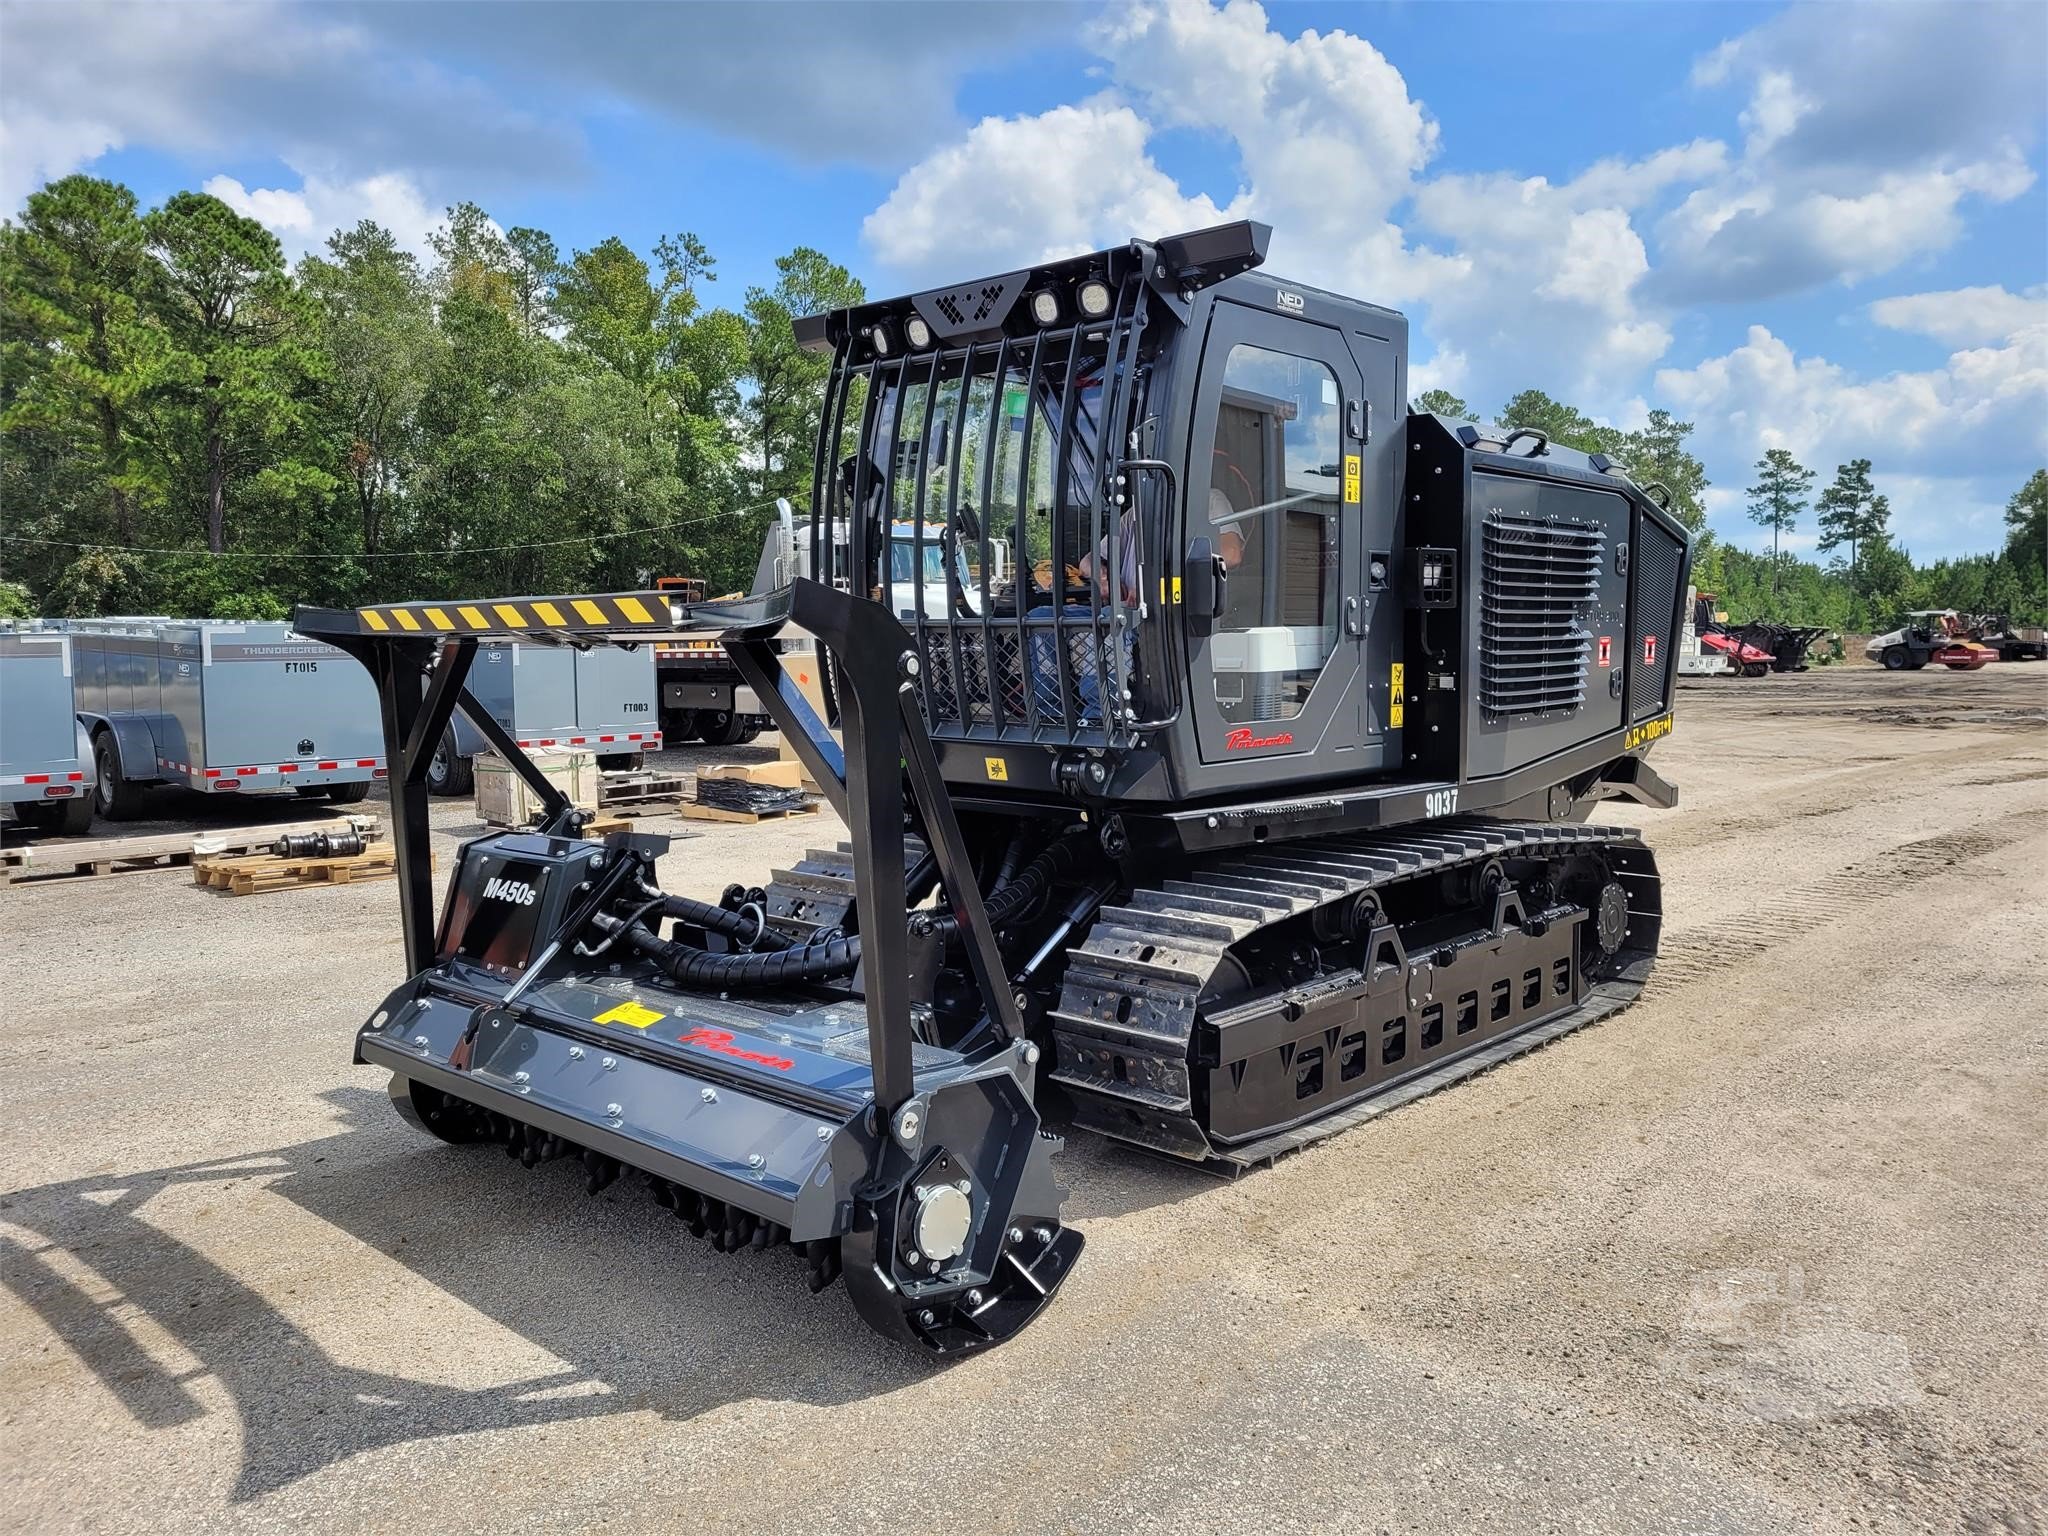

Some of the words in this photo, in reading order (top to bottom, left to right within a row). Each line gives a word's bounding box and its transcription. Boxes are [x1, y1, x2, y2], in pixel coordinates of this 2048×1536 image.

[1277, 288, 1304, 309] NED
[488, 652, 501, 660] NED
[285, 662, 317, 673] FT015
[623, 703, 648, 712] FT003
[1426, 789, 1458, 818] 9037
[482, 877, 536, 906] M450s
